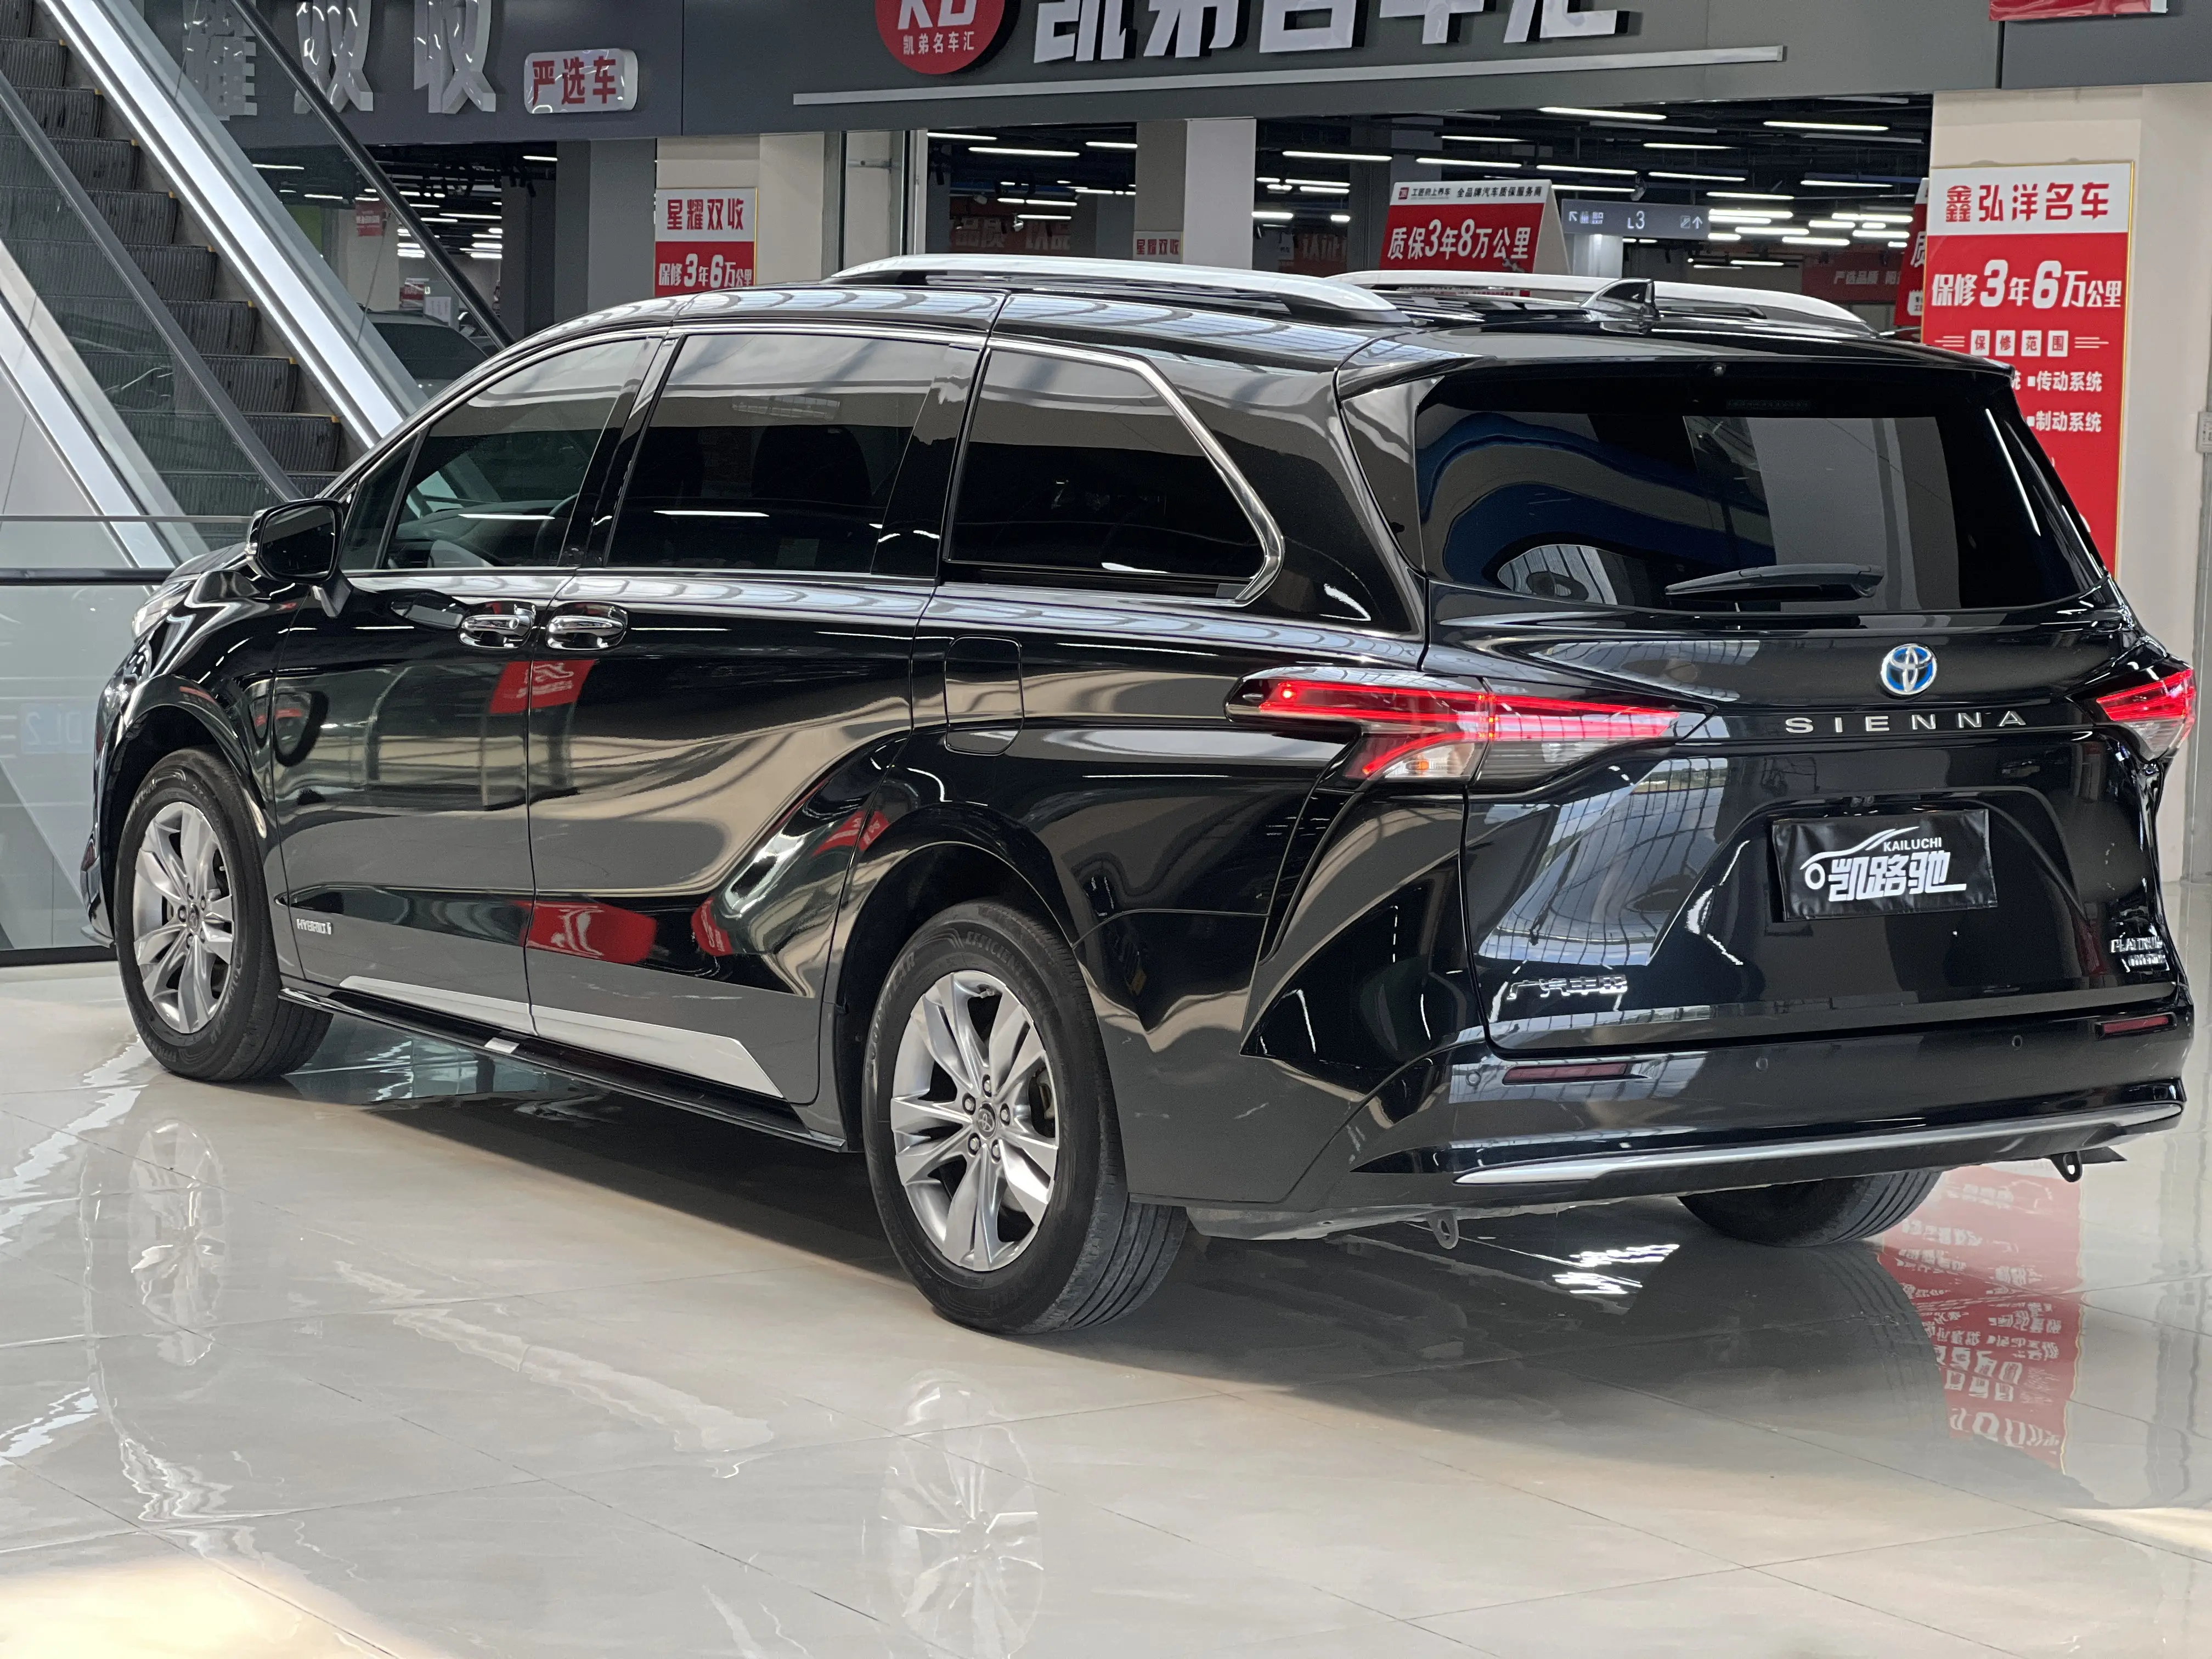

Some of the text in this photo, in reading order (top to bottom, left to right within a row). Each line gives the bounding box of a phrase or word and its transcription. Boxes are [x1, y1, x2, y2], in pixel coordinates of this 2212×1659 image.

[903, 31, 974, 55] 凯弟名车汇
[533, 56, 616, 106] 严选车
[667, 198, 744, 230] 星耀双收
[1945, 182, 2109, 222] 鑫弘洋名车
[1628, 211, 1645, 229] L3
[1387, 219, 1531, 259] 质保3年8万公里
[658, 253, 752, 288] 保修3年6万公里
[1931, 259, 2122, 309] 保修3年6万公里
[1974, 335, 2064, 352] 保修范围
[2036, 370, 2102, 392] 传动系统
[2036, 410, 2102, 432] 制动系统
[1785, 710, 2026, 733] SIENNA
[1883, 837, 1942, 852] KAILUCHI
[1829, 850, 1967, 902] 凯路驰
